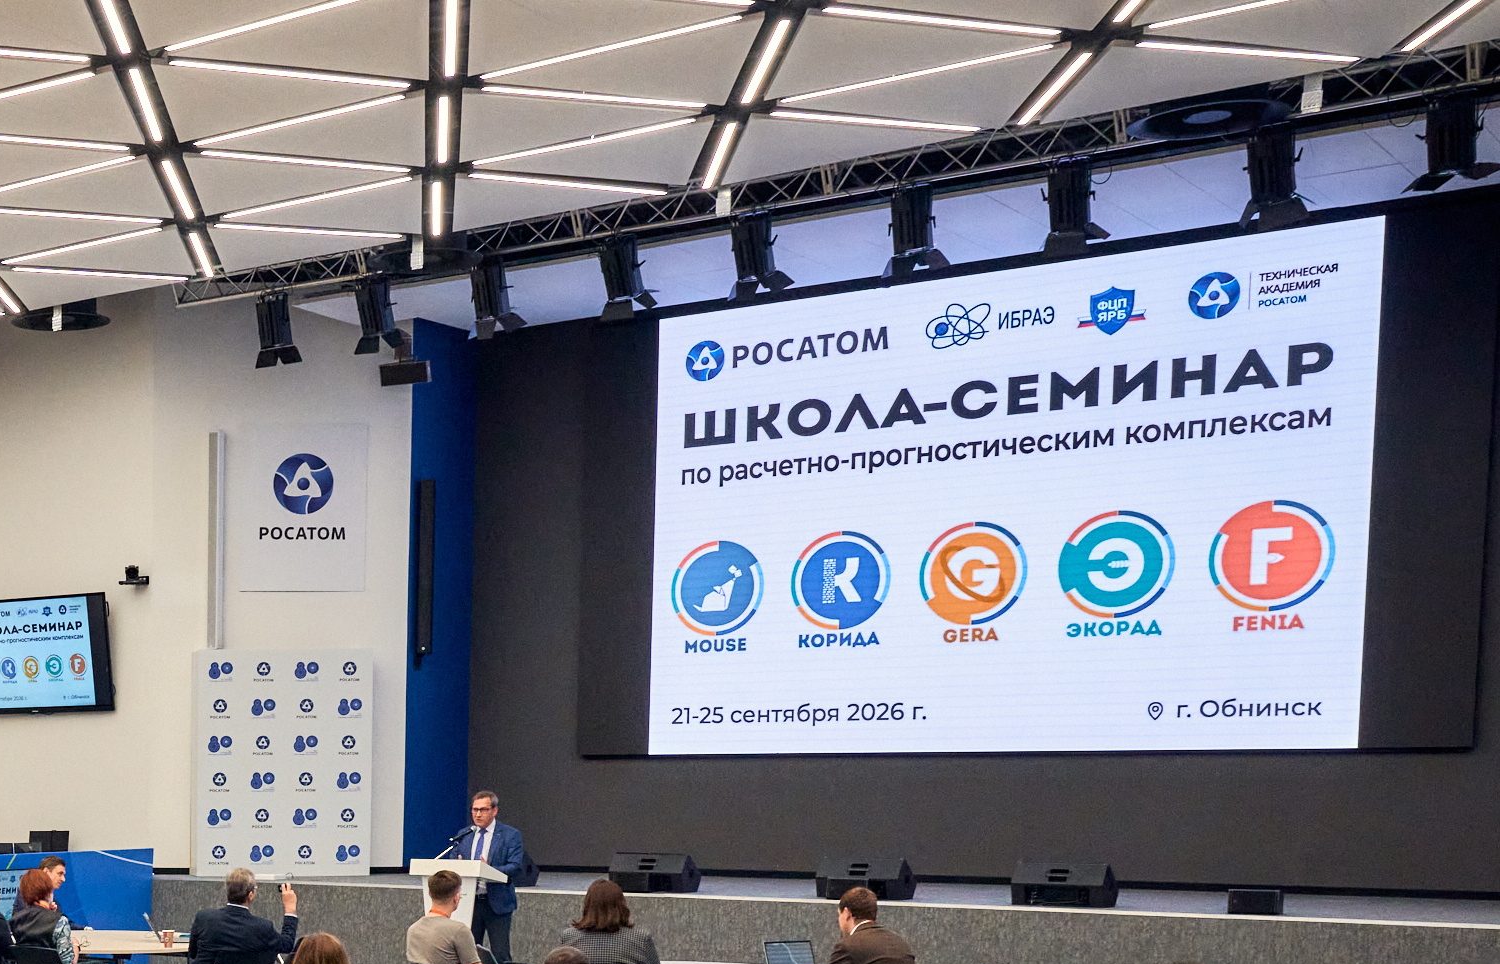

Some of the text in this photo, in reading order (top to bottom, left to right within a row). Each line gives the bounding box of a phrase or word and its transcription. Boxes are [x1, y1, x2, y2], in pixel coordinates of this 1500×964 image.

[1259, 263, 1338, 282] ТЕХНИЧЕСКАЯ
[1258, 278, 1321, 295] АКАДЕМИЯ
[1097, 297, 1128, 313] ФЦП
[1258, 294, 1307, 308] РОСАТОМ
[998, 306, 1055, 330] ИБРАЭ
[1097, 310, 1127, 323] ЯРБ
[732, 326, 889, 369] РОСАТОМ
[683, 342, 1334, 449] ШКОЛА-СЕМИНАР
[681, 407, 1332, 486] по расчетно-прогностическим комплексам
[259, 527, 346, 540] РОСАТОМ
[1066, 619, 1162, 638] ЭКОРАД
[1233, 614, 1305, 631] FENIA
[798, 631, 880, 648] КОРИДА
[943, 627, 999, 643] GERA
[684, 638, 747, 653] MOUSE
[671, 702, 927, 726] 21-25 сентября 2026 г.
[1177, 698, 1322, 718] г. Обнинск
